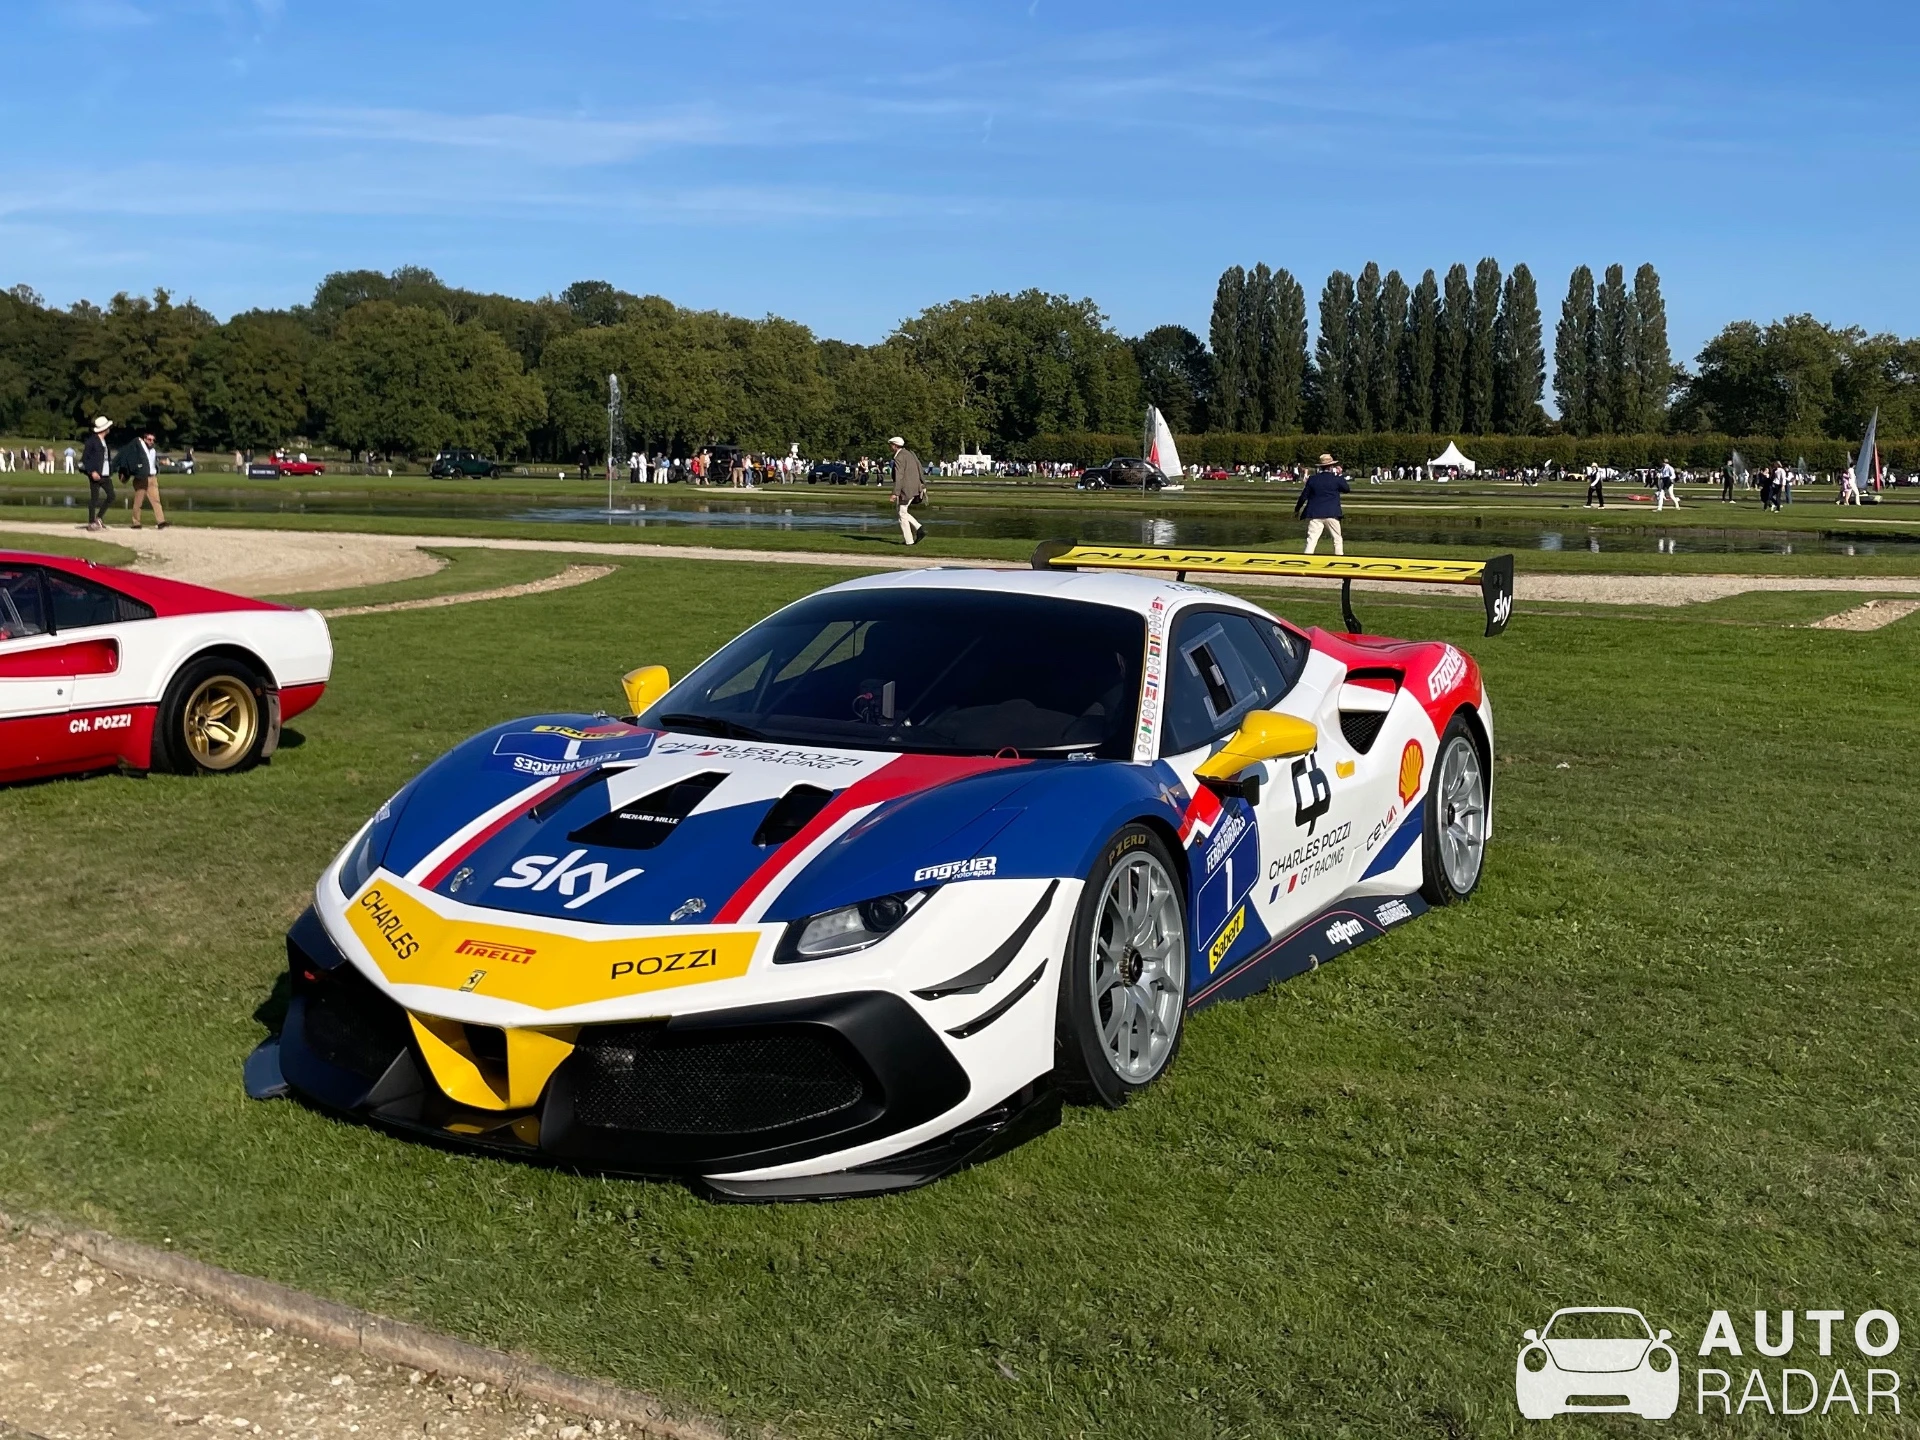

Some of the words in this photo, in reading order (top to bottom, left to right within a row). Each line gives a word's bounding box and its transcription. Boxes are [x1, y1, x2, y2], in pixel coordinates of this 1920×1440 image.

[1075, 552, 1313, 568] CHARLES
[1493, 589, 1512, 627] sky
[69, 718, 91, 734] CH.
[94, 713, 132, 731] POZZI
[563, 739, 582, 761] 1
[657, 742, 780, 756] CHARLES
[781, 750, 864, 767] POZZI
[722, 752, 750, 760] GT
[750, 755, 837, 770] RACING
[619, 812, 655, 822] RICHARD
[654, 816, 680, 825] MILLE
[1108, 850, 1116, 867] P
[1115, 834, 1147, 857] ZERO
[1269, 838, 1321, 881] CHARLES
[1320, 820, 1352, 853] POZZI
[1301, 863, 1315, 886] GT
[1312, 846, 1345, 879] RACING
[493, 849, 645, 909] sky
[1225, 857, 1234, 913] 1
[360, 889, 420, 960] CHARLES
[1213, 913, 1241, 966] Sabelt
[1325, 918, 1365, 945] rotiform
[454, 938, 538, 965] PIRELLI
[611, 947, 717, 981] POZZI
